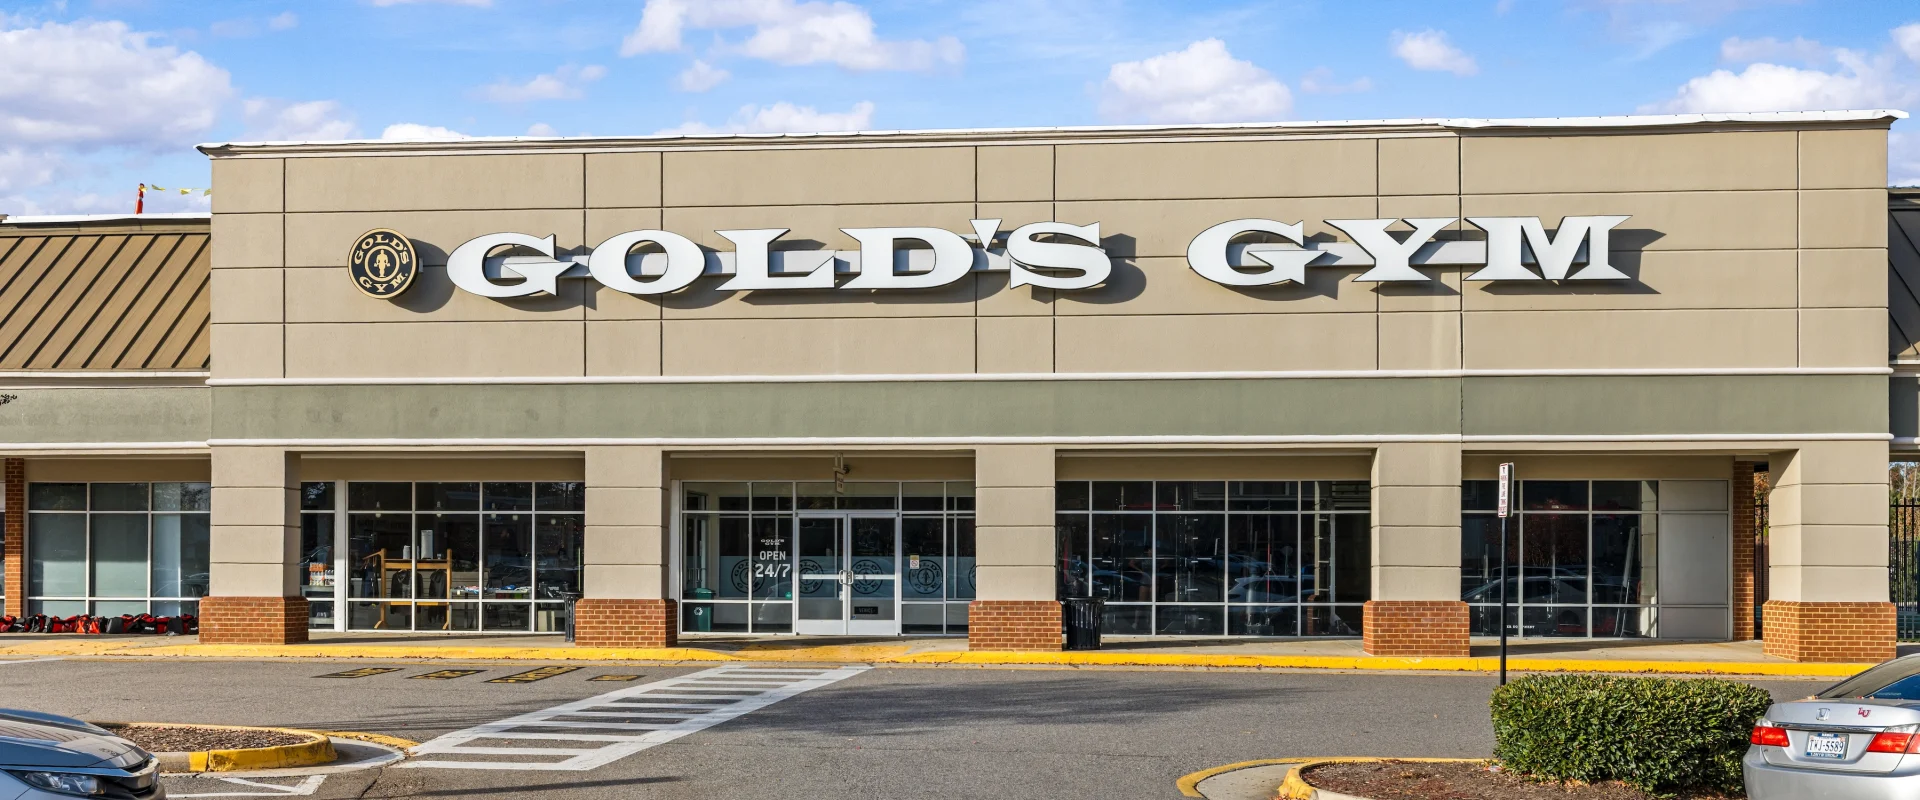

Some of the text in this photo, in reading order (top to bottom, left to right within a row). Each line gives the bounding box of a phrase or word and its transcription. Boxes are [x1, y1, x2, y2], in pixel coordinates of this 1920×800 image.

[354, 234, 410, 265] GOLD'S
[446, 215, 1633, 298] GOLD'S GYM
[759, 550, 786, 561] OPEN
[754, 563, 791, 578] 24/7
[1858, 707, 1871, 718] LU
